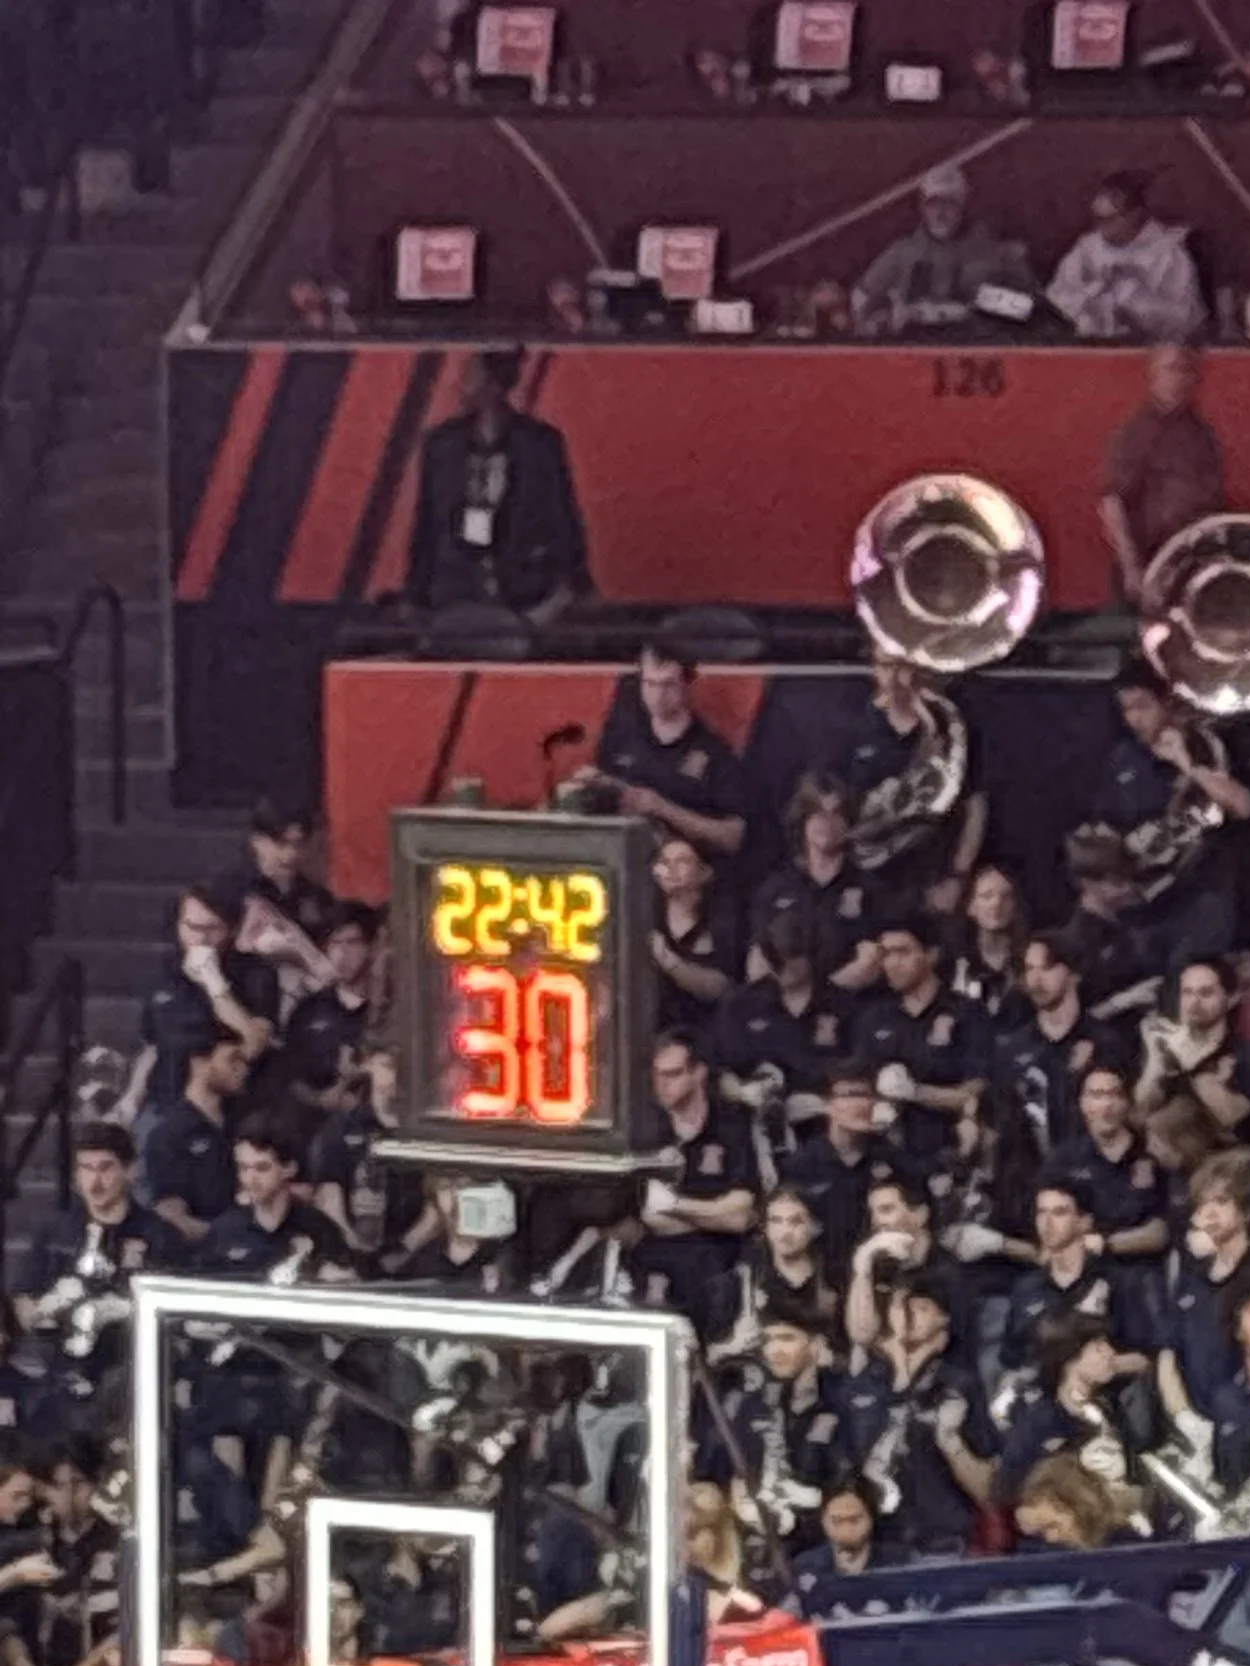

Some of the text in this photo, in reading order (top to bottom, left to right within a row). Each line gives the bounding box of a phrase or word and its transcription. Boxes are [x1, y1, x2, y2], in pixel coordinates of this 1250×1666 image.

[930, 357, 1007, 399] 126
[434, 863, 606, 962] 22:42
[457, 966, 588, 1121] 30
